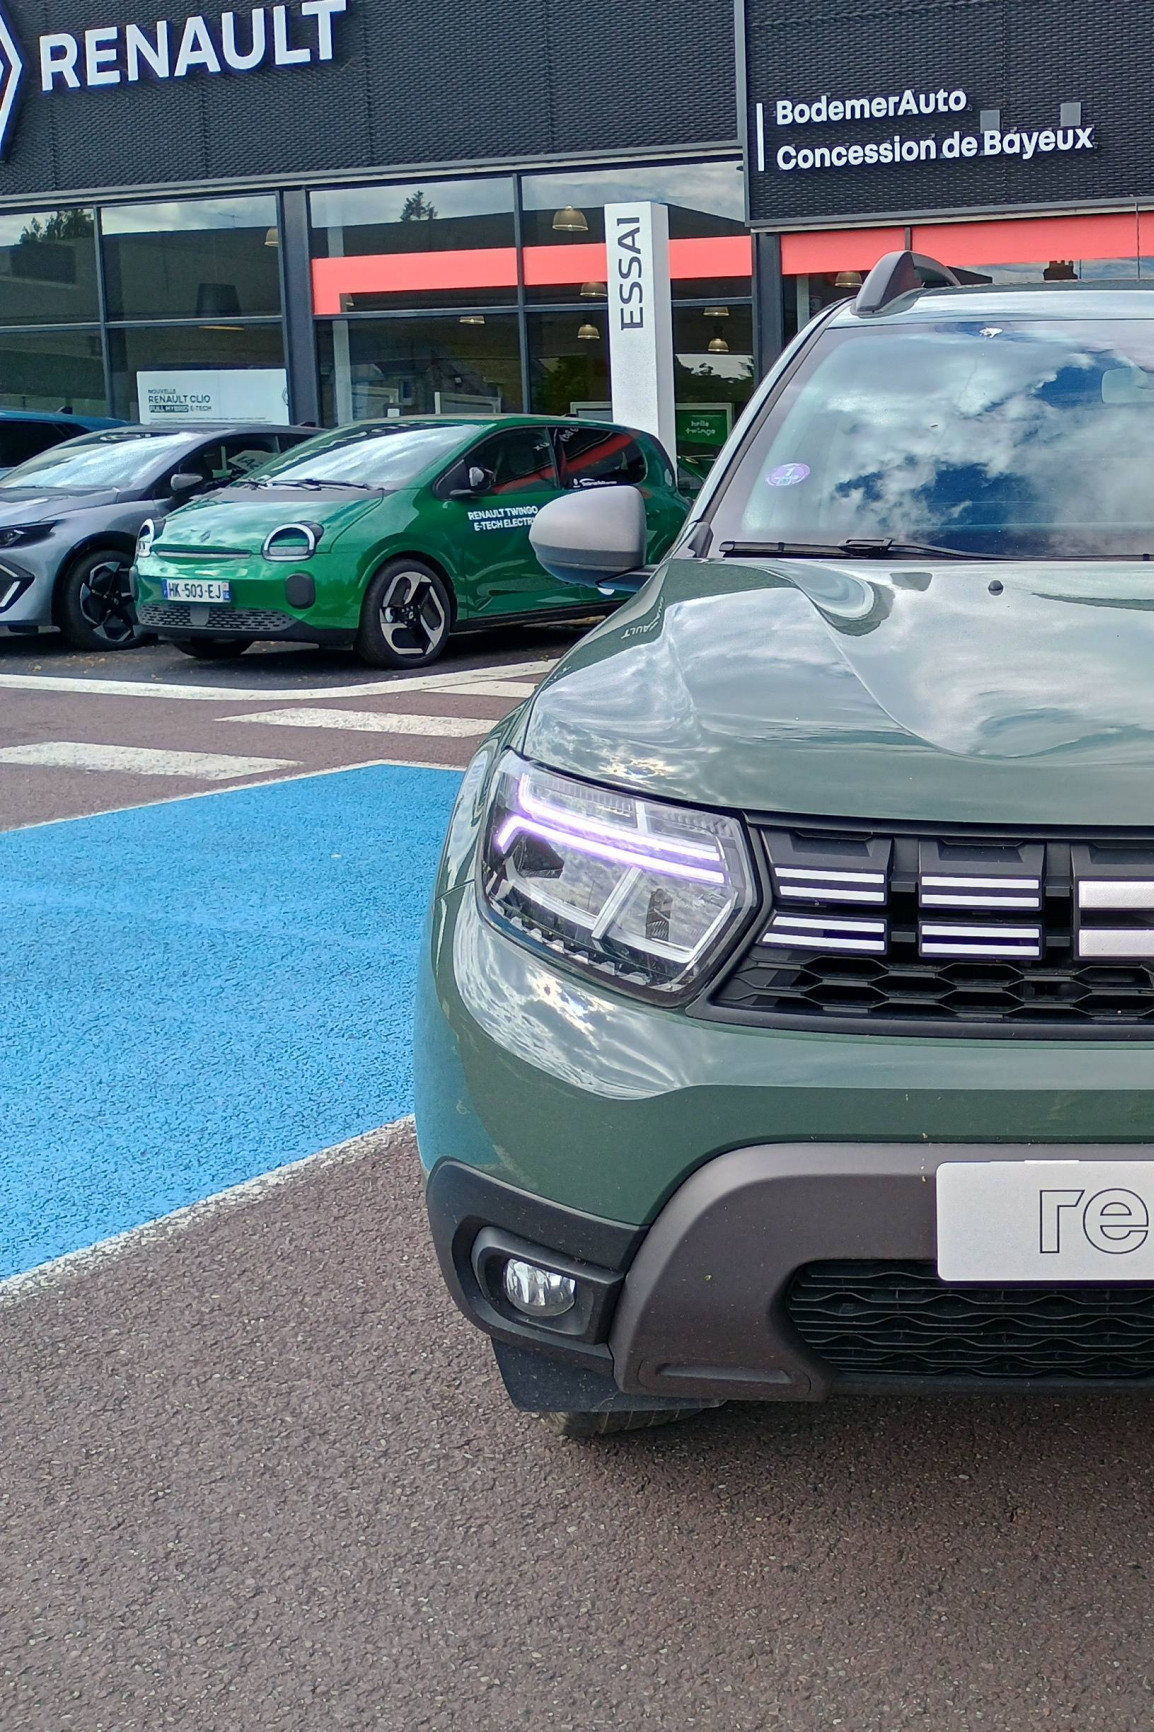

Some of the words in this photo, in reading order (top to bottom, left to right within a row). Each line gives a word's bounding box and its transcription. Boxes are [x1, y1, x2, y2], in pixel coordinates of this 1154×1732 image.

[39, 0, 347, 92] RENAULT
[776, 88, 968, 125] BodemerAuto
[776, 136, 937, 171] Concession
[942, 131, 978, 159] de
[983, 127, 1094, 160] Bayeux
[617, 217, 643, 330] ESSAI
[148, 395, 188, 403] RENAULT
[190, 394, 211, 403] CLIO
[467, 508, 505, 520] RENAULT
[504, 505, 539, 517] TWINGO
[473, 519, 504, 532] E-TECH
[503, 516, 535, 528] ELECTR
[168, 582, 222, 599] HK-503-EJ
